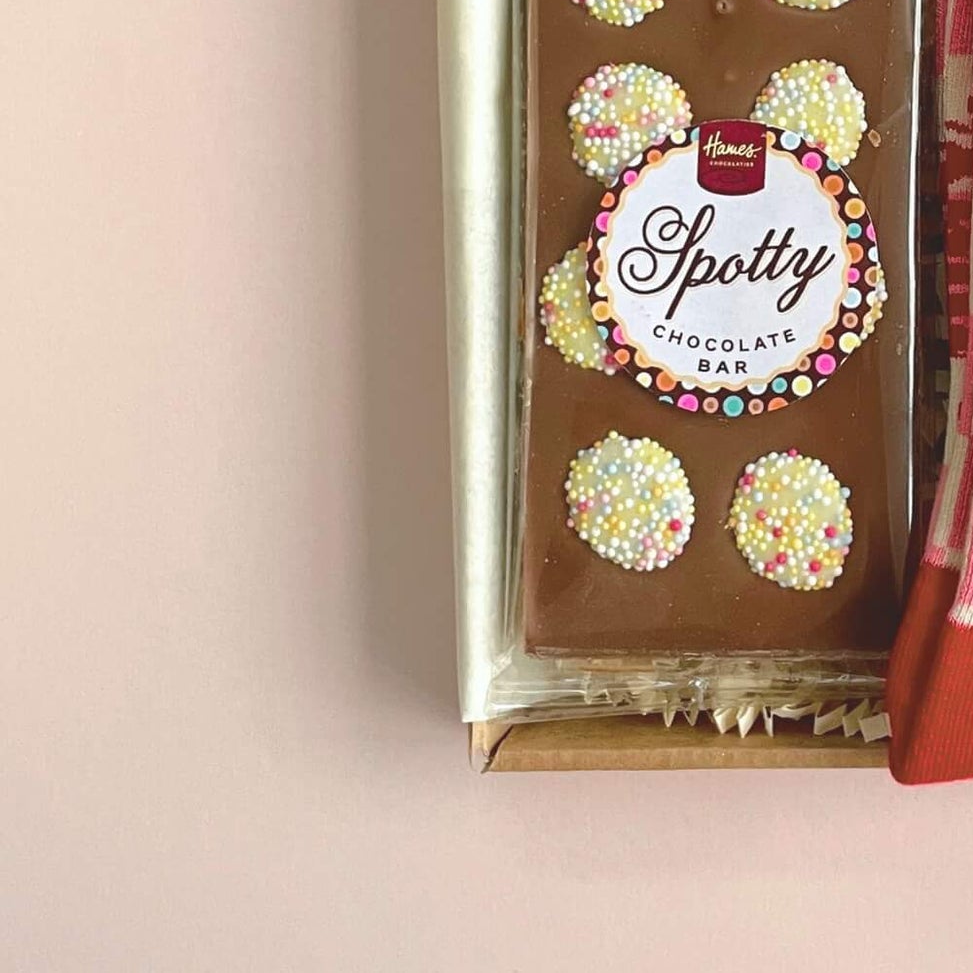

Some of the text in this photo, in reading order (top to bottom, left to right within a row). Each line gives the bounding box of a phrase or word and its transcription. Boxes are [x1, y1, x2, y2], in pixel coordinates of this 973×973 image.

[617, 204, 836, 320] Spotty
[653, 325, 796, 352] CHOCOLATE
[698, 359, 748, 374] BAR
